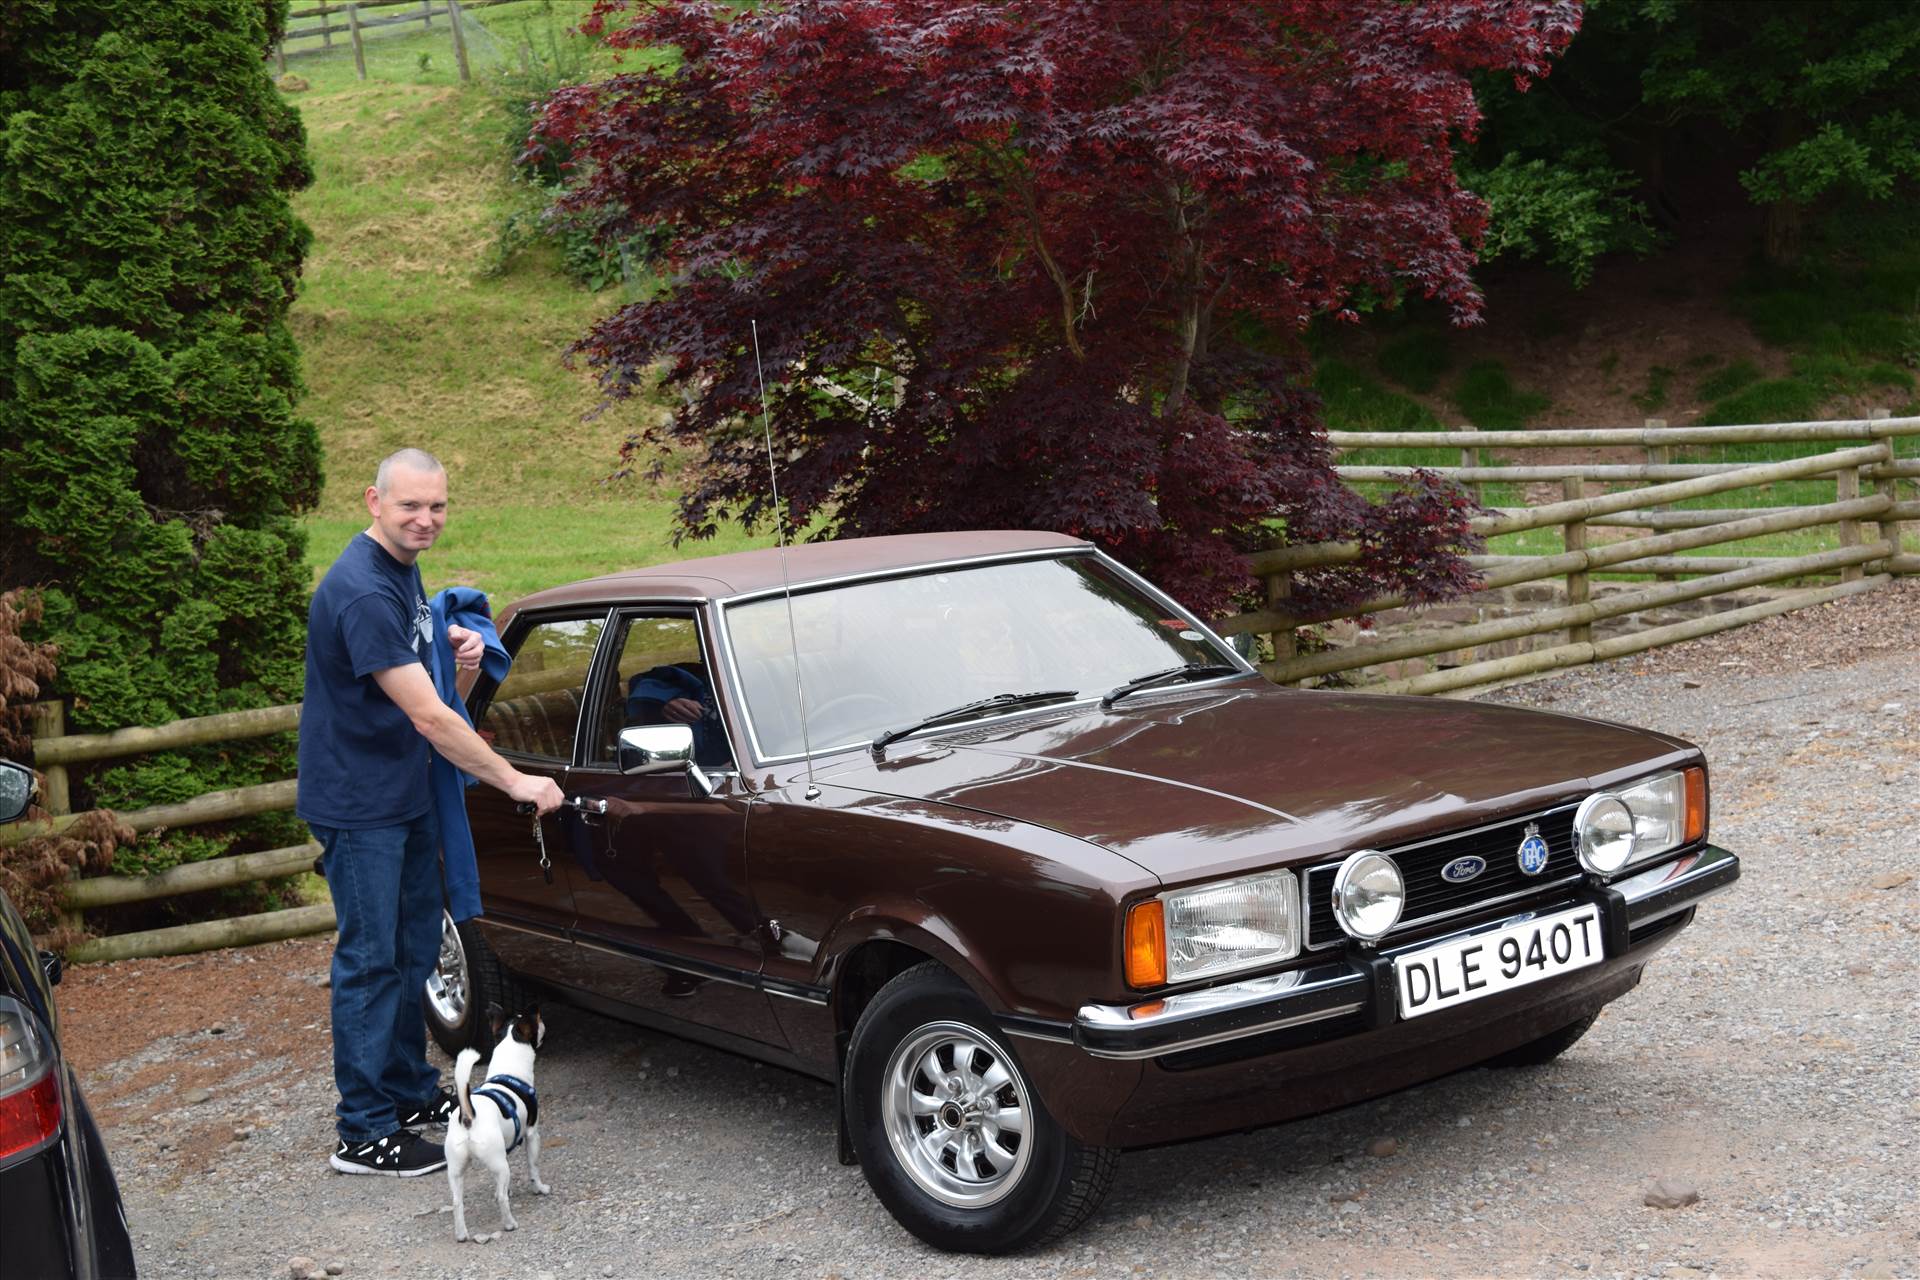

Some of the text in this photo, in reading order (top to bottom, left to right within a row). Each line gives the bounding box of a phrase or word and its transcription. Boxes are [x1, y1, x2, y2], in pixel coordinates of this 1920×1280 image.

[1524, 840, 1545, 868] RAC
[1453, 860, 1477, 878] Ford
[1405, 913, 1595, 1008] DLE 940T
